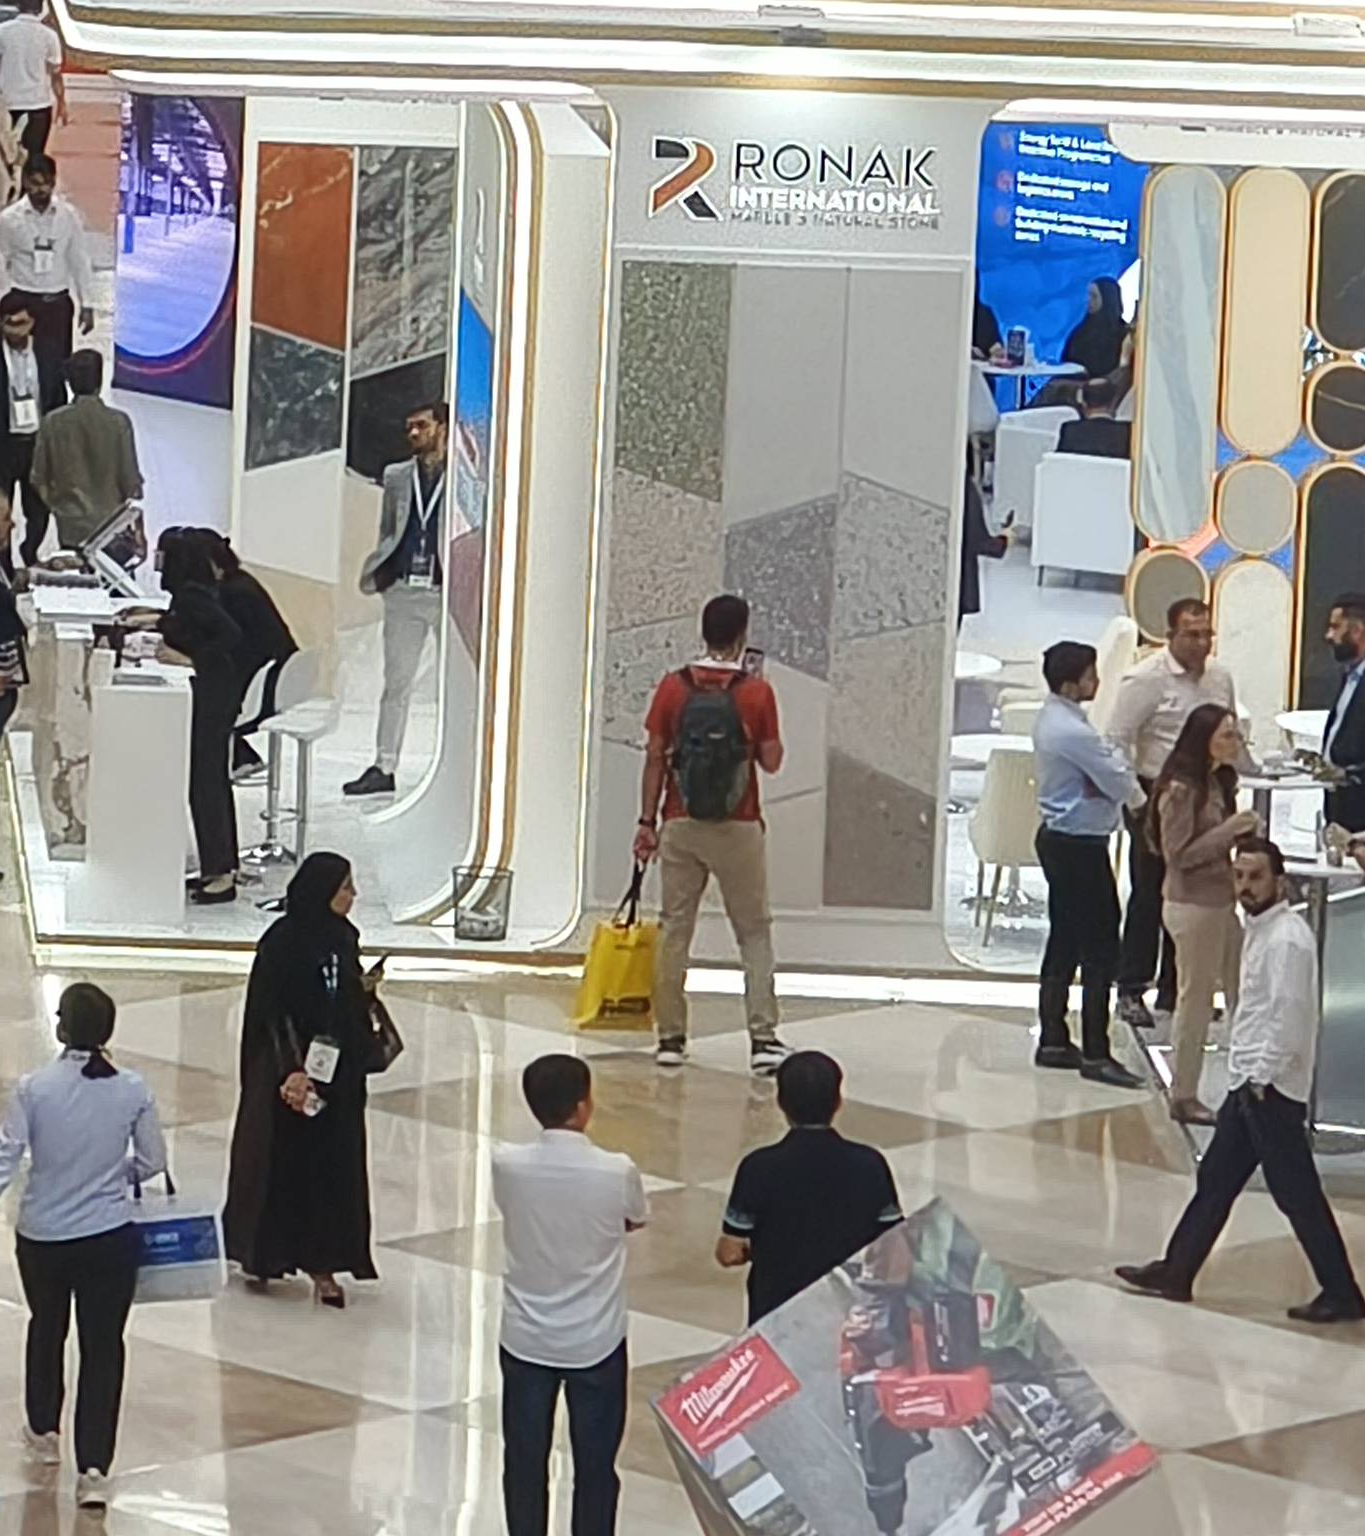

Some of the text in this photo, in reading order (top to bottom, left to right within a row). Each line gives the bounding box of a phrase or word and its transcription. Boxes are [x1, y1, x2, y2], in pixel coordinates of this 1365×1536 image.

[736, 143, 936, 186] RONAK
[729, 186, 941, 215] INTERNATIONAL
[888, 216, 939, 230] STONE
[679, 1348, 756, 1425] Milwaukee
